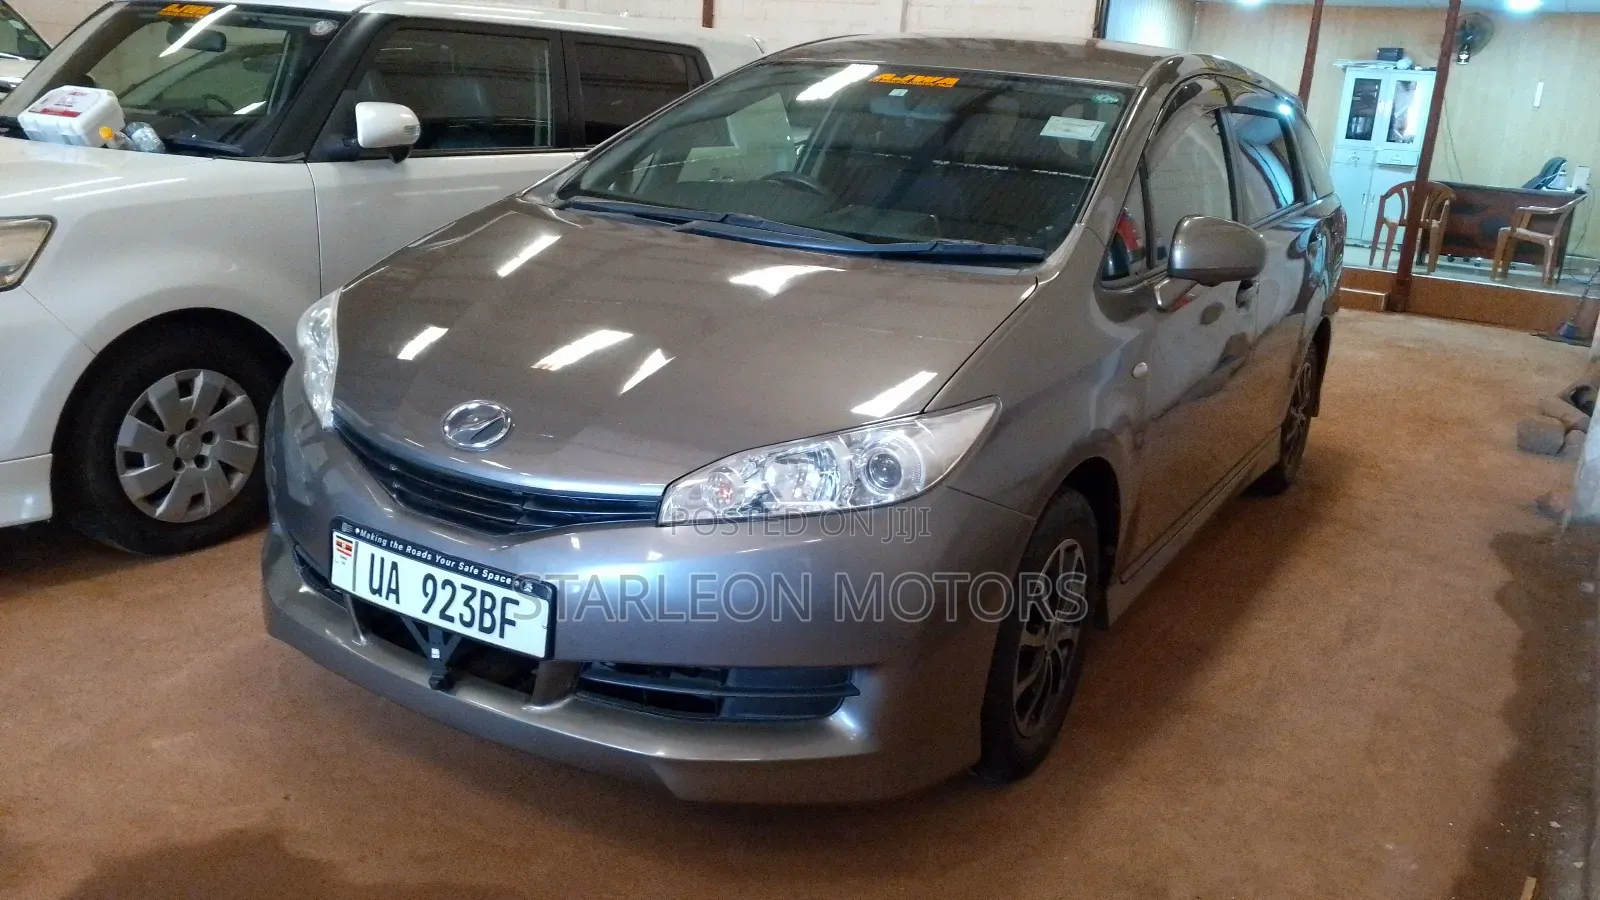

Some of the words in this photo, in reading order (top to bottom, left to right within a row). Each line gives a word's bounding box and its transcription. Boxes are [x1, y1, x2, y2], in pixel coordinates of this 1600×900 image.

[360, 529, 388, 546] Making
[389, 540, 404, 551] the
[405, 545, 432, 560] Roads
[435, 555, 456, 567] Your
[458, 562, 479, 575] Safe
[482, 569, 512, 585] Space
[368, 553, 401, 605] UA
[421, 572, 520, 639] 923BF
